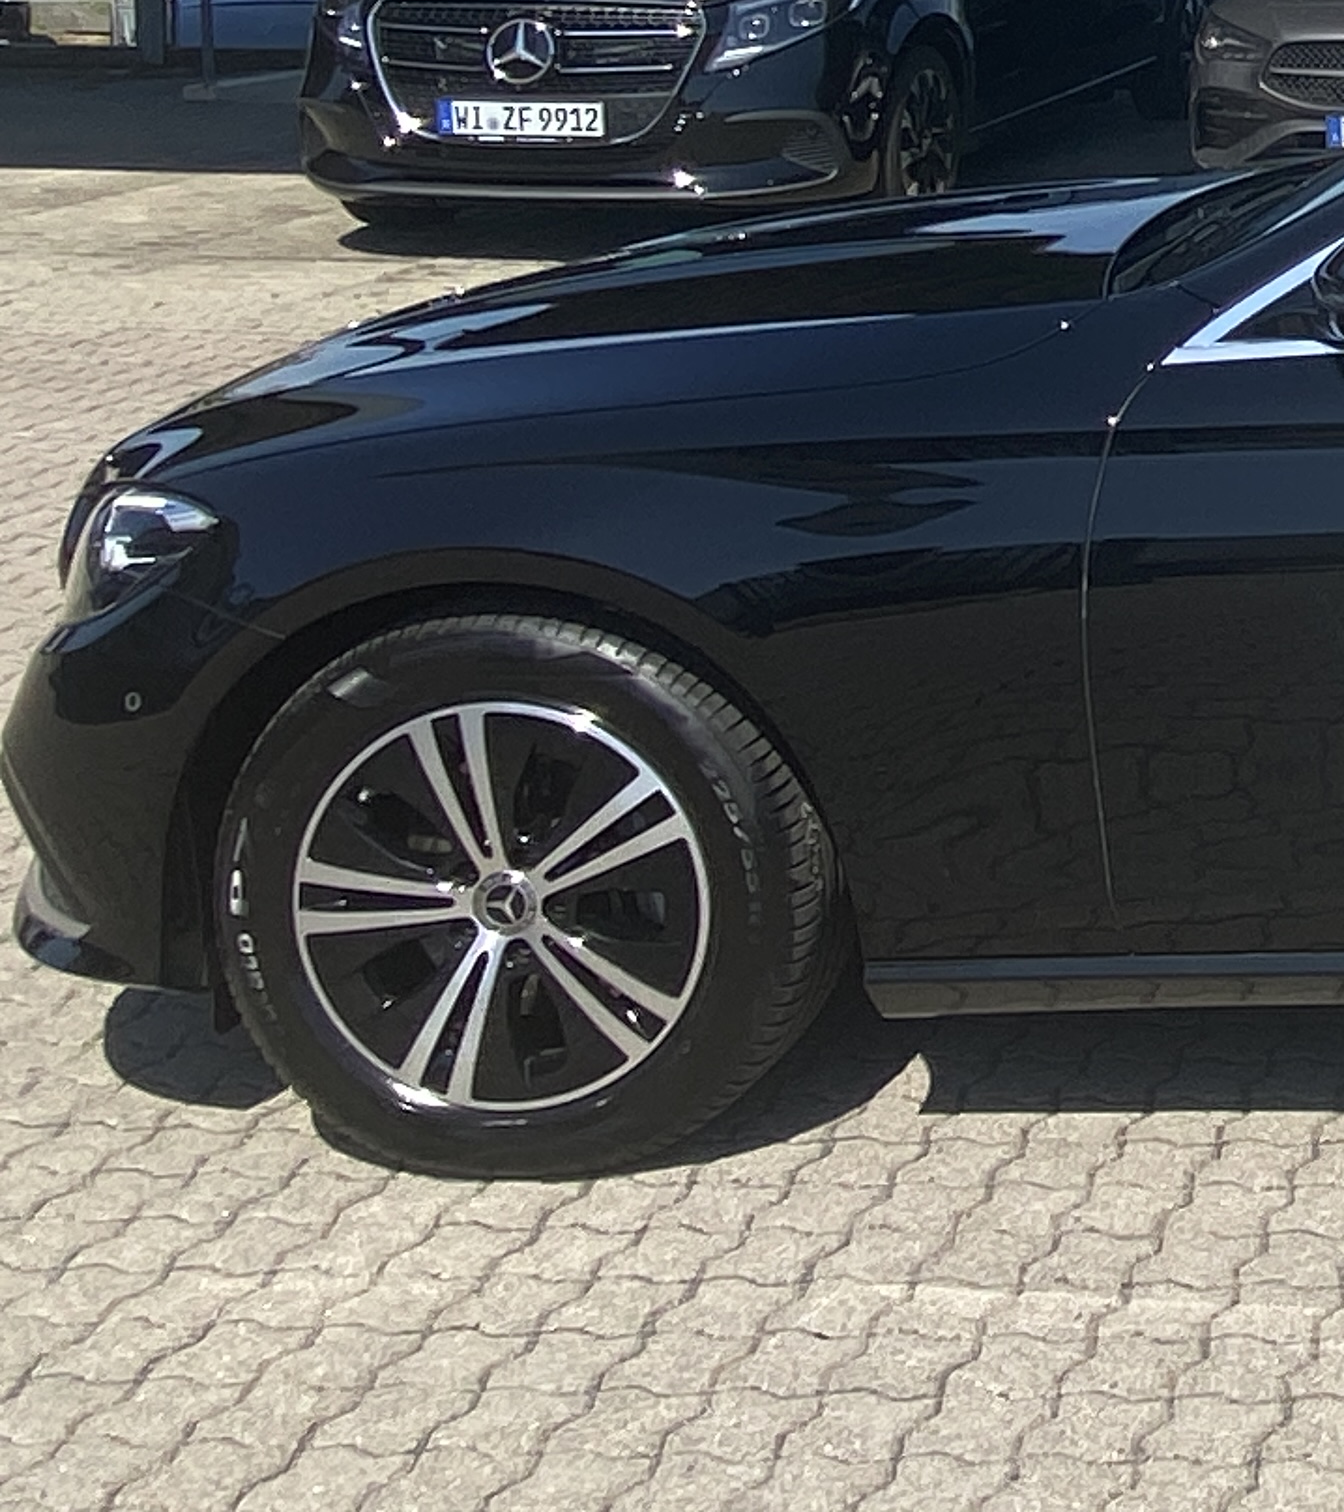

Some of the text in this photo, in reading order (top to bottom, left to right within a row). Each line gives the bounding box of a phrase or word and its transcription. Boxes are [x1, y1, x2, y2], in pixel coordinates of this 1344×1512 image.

[455, 106, 599, 132] WI ZF 9912
